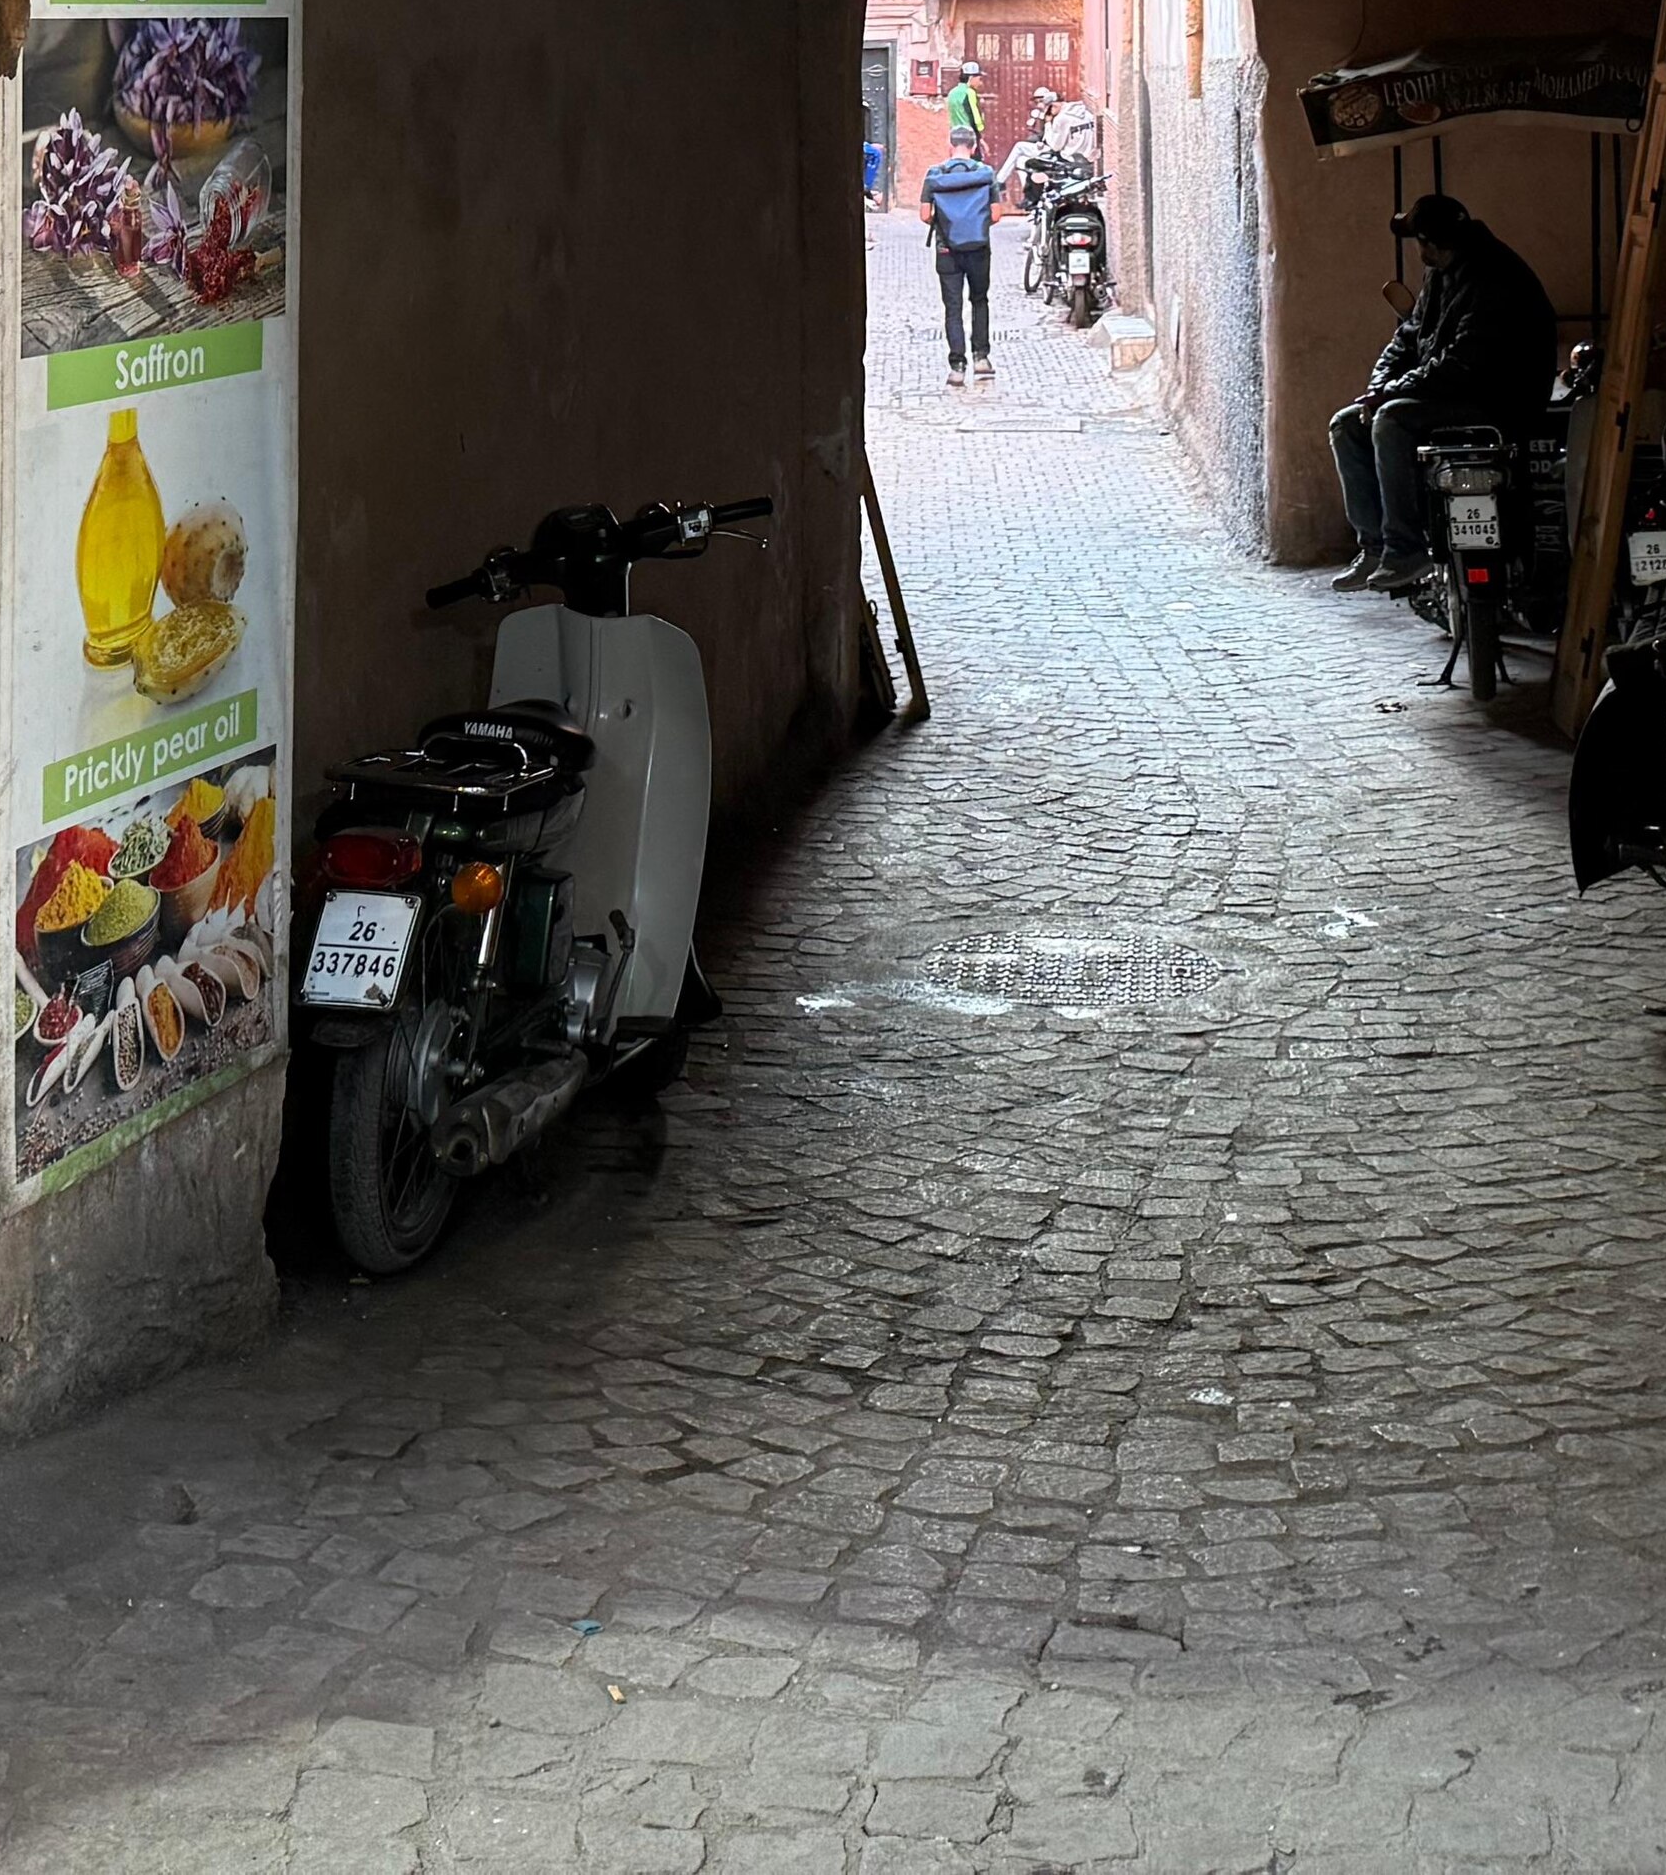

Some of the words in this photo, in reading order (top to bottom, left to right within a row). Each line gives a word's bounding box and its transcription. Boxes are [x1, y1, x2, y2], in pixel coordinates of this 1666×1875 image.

[115, 342, 205, 391] Saffron
[1467, 508, 1481, 520] 26
[1453, 523, 1497, 536] 341045
[1646, 543, 1661, 555] 26
[464, 721, 513, 740] YAMAHA
[64, 741, 146, 804] Prickly
[153, 721, 209, 777] pear
[214, 701, 240, 743] oil
[348, 920, 378, 942] 26
[311, 950, 397, 979] 337846
